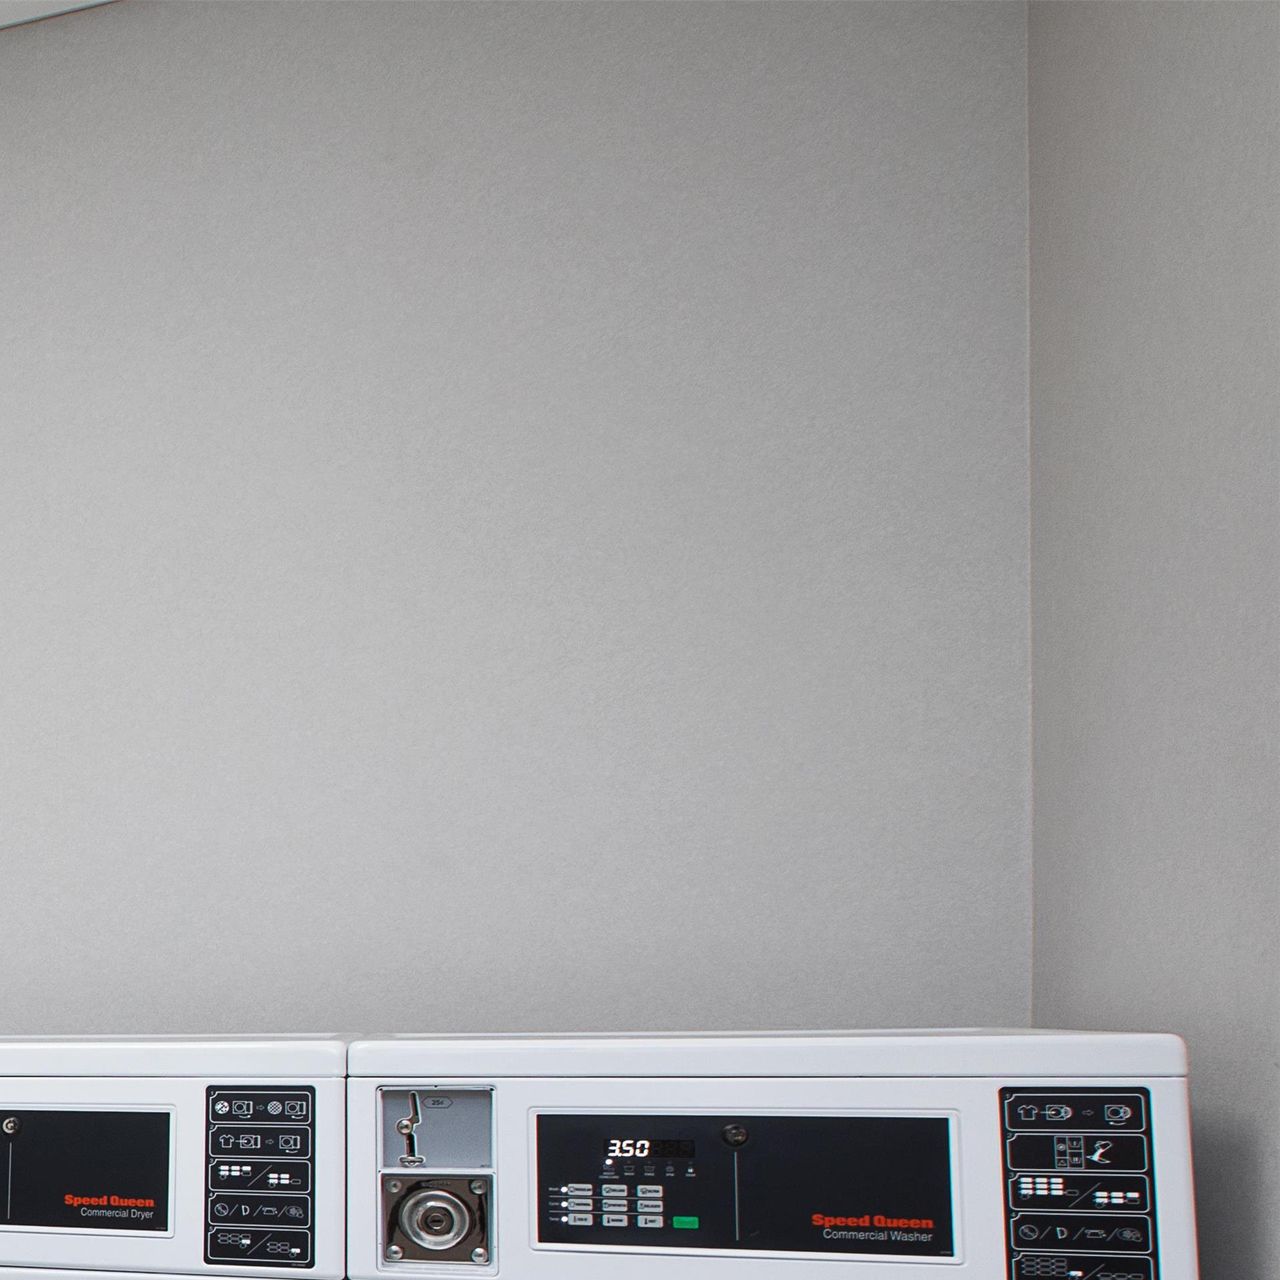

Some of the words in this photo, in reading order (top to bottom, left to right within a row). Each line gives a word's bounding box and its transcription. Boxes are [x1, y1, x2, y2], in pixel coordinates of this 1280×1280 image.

[608, 1139, 650, 1157] 3.50
[64, 1194, 107, 1207] Speed
[110, 1195, 155, 1208] Queen
[80, 1207, 129, 1218] Commercial
[130, 1209, 154, 1220] Dryer
[811, 1213, 870, 1228] Speed
[873, 1215, 934, 1229] Queen
[823, 1228, 888, 1240] Commercial
[890, 1231, 933, 1242] Washer
